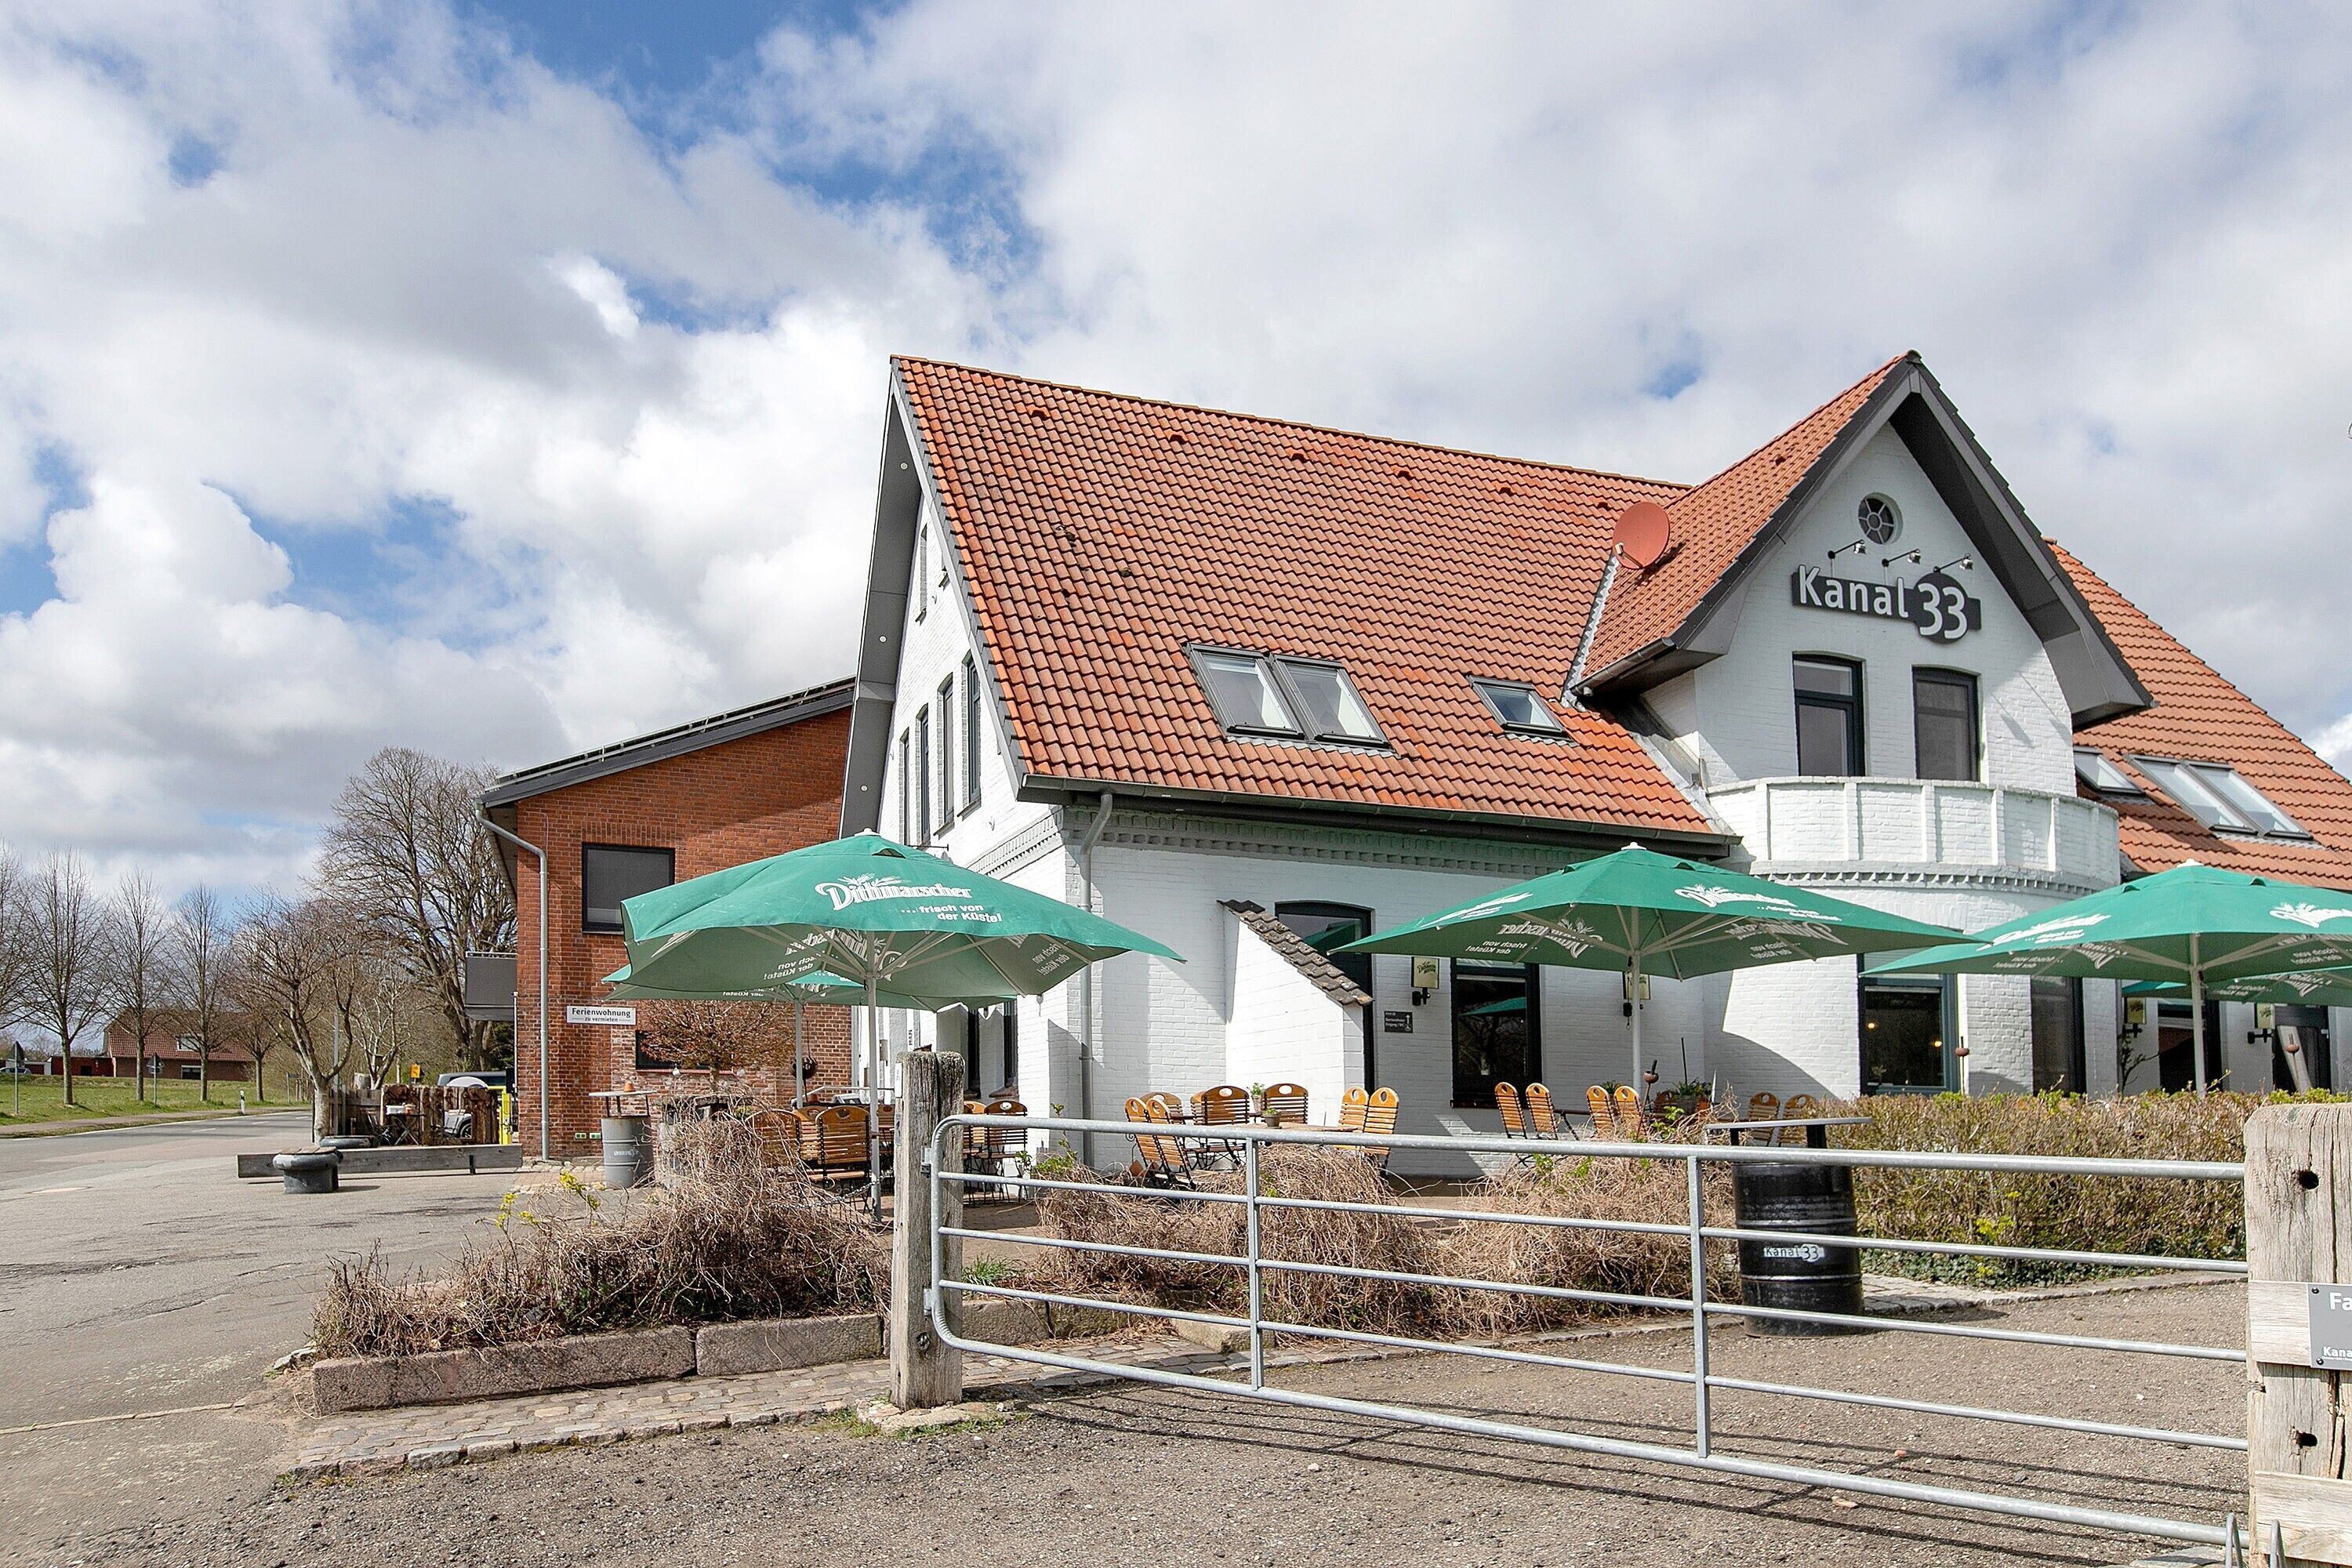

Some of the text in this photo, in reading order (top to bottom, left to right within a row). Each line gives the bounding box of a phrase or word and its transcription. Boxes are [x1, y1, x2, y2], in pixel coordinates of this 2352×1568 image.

[1798, 564, 1968, 640] Kanal 33
[814, 882, 973, 911] Dithmarscher
[919, 904, 957, 913] frisch
[937, 912, 959, 920] der
[572, 1007, 631, 1018] Ferienwohnung
[1766, 1245, 1819, 1260] Kanal 33
